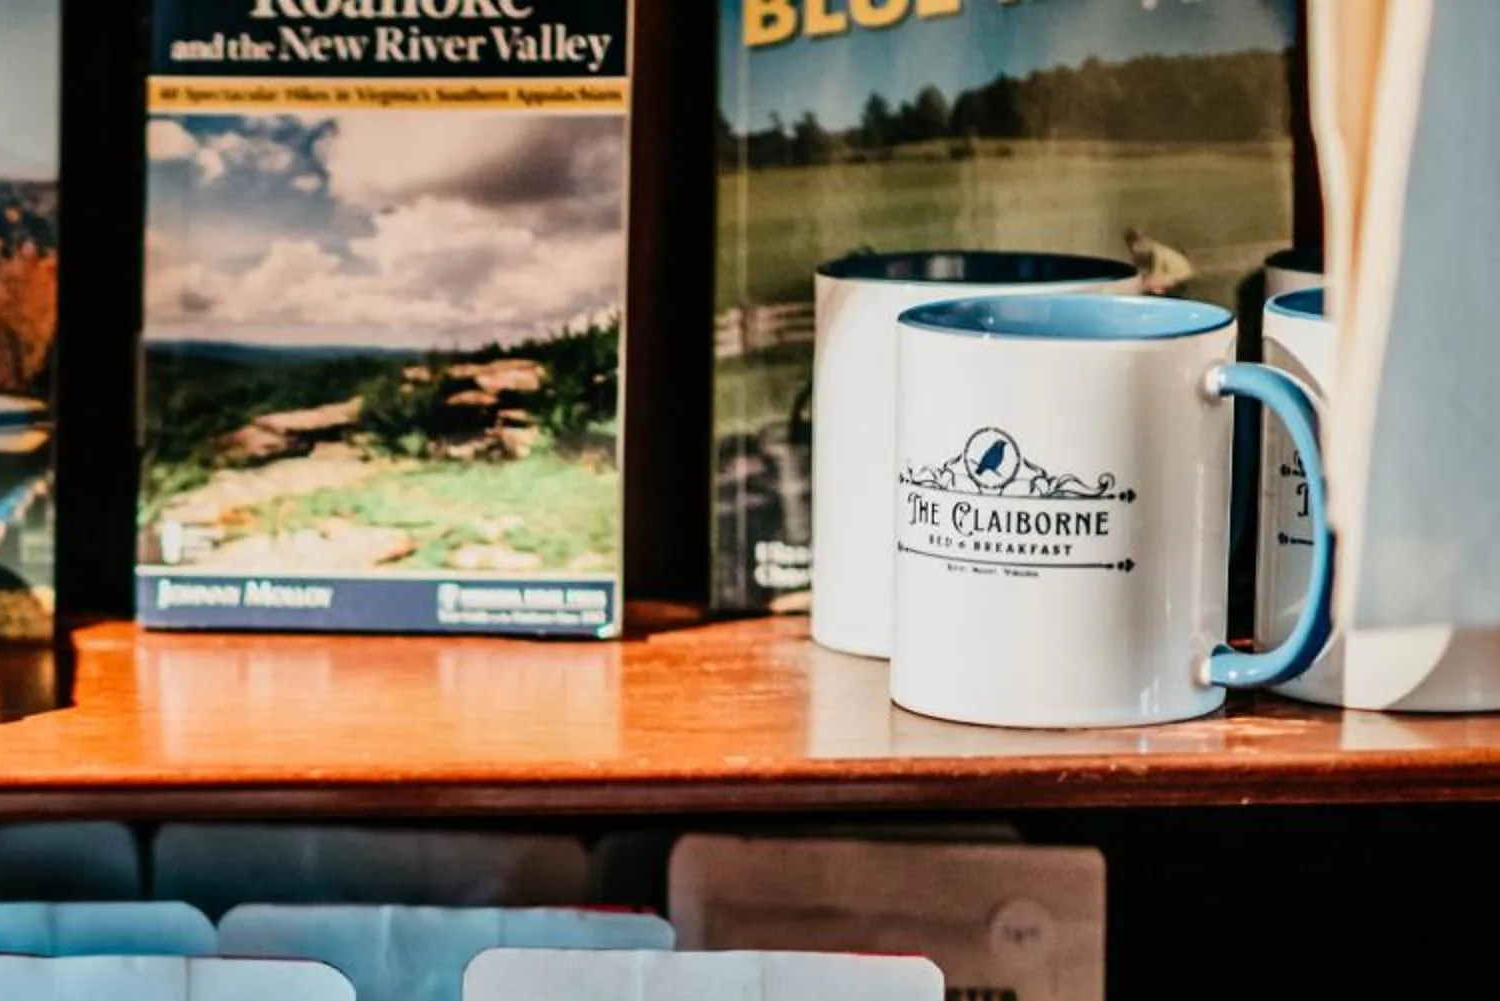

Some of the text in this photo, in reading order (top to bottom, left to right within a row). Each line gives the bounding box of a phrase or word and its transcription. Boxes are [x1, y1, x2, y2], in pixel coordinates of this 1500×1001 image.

[170, 23, 612, 72] and the New River Valley
[908, 492, 1109, 537] THE CLAIBORNE
[973, 541, 1073, 556] BREAKFAST
